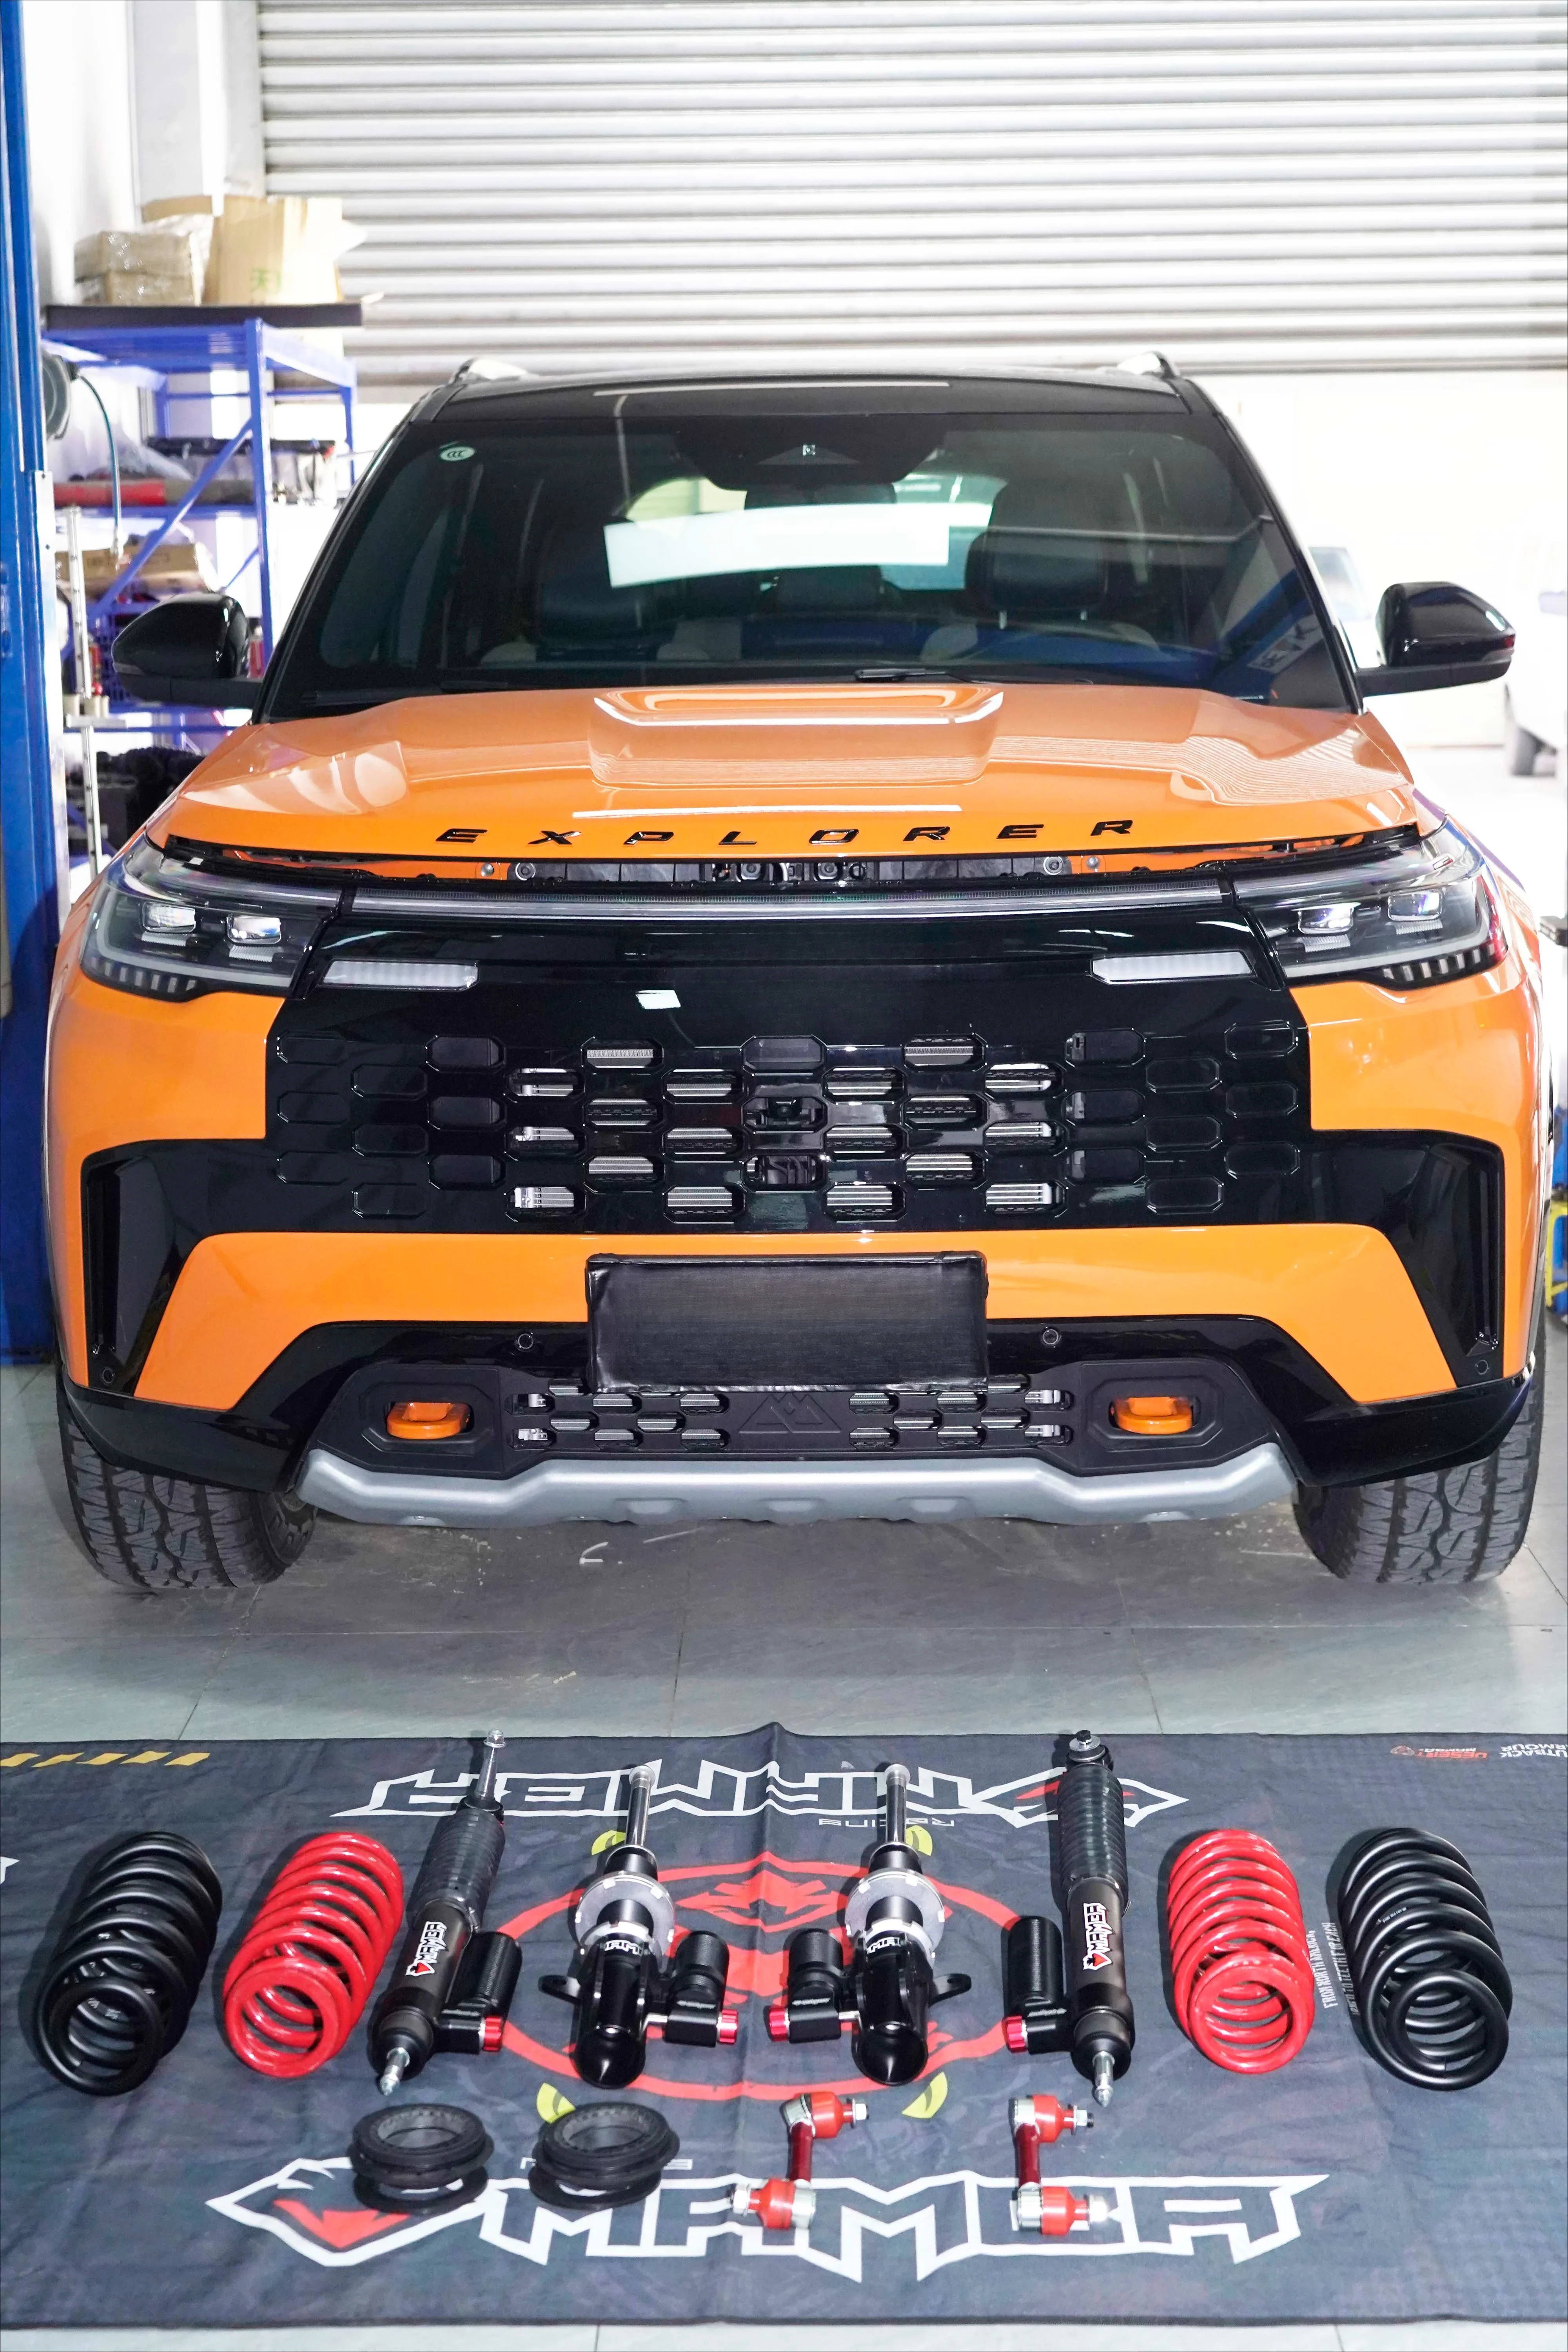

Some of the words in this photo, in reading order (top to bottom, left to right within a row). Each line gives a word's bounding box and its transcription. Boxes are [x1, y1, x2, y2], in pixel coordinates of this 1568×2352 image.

[435, 819, 1133, 846] EXPLORER
[1499, 1749, 1568, 1758] UTBACK
[1501, 1744, 1568, 1752] RMOUR
[413, 1921, 447, 1964] MAMBA
[1083, 1902, 1113, 1954] MAMBA
[479, 2169, 1330, 2282] MAMBA
